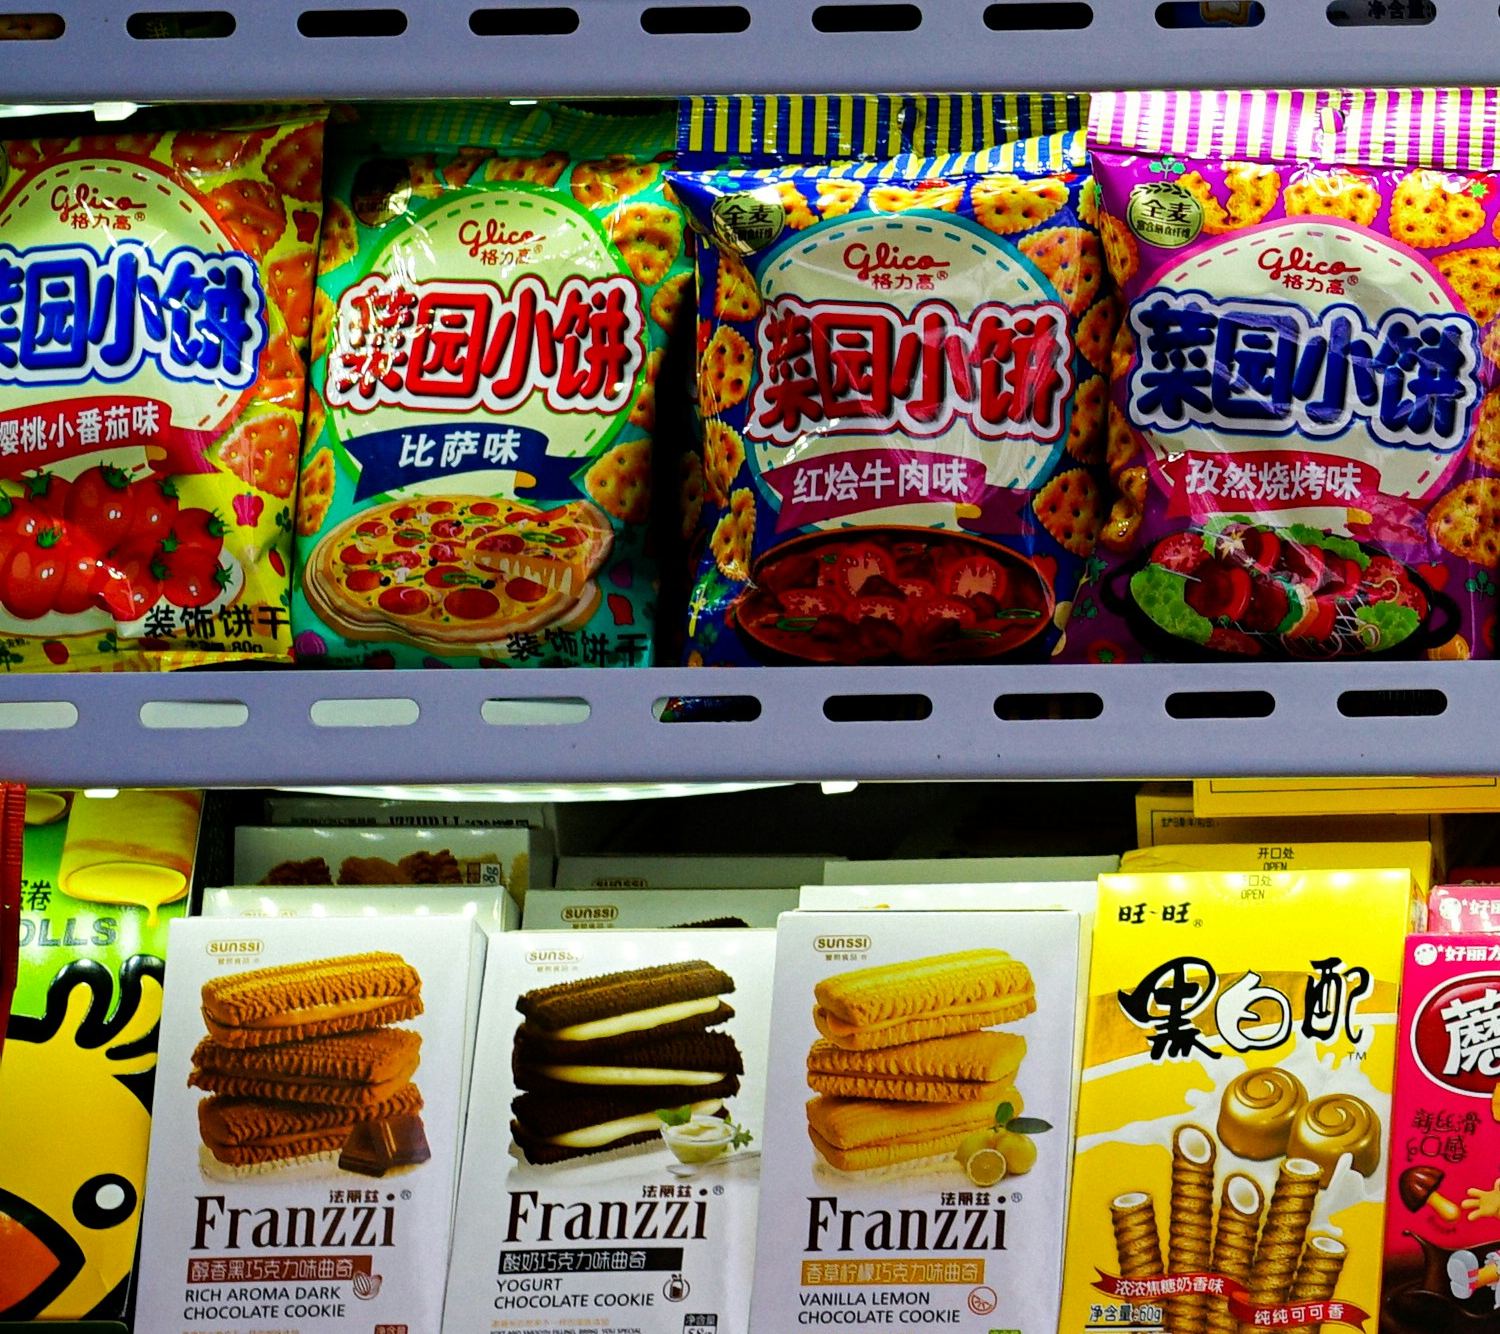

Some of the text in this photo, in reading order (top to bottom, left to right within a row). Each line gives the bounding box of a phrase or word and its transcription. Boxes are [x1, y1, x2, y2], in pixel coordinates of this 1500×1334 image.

[335, 287, 638, 403] 菜园小饼
[763, 312, 1063, 434] 菜园小饼
[400, 430, 520, 469] 比萨味
[791, 459, 968, 502] 红烩牛肉味
[1185, 459, 1362, 502] 孜然烧烤味
[1258, 847, 1294, 861] 开口处
[1119, 956, 1372, 1061] 黑白配
[329, 1189, 379, 1205] 法丽兹
[191, 1195, 395, 1249] Franzzi
[191, 1259, 354, 1281] 醇香黑巧克力味曲奇
[186, 1286, 341, 1302] RICH AROMA DARK
[497, 1278, 561, 1293] YOGURT
[1116, 1276, 1224, 1297] 浓浓焦糖奶香味
[799, 1291, 929, 1306] VANILLA LEMON
[184, 1304, 345, 1319] CHOCOLATE COOKIE
